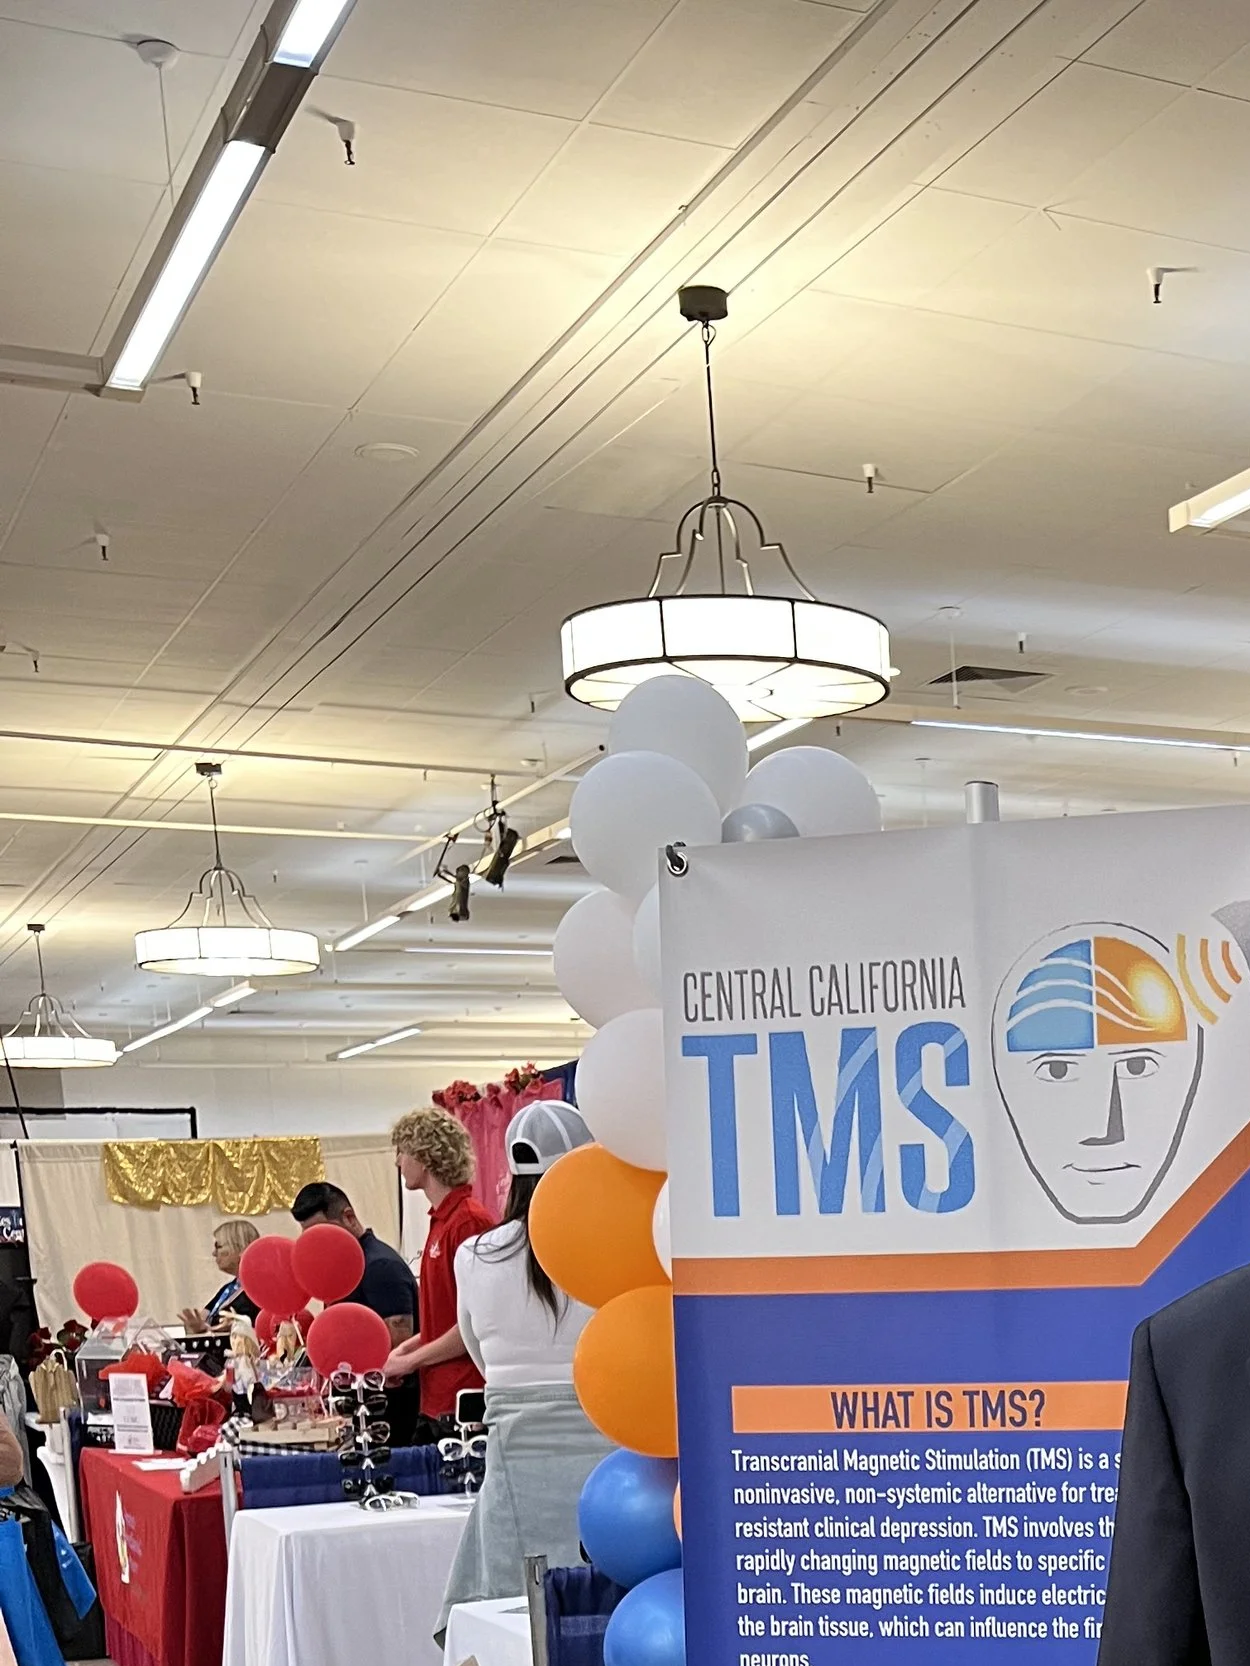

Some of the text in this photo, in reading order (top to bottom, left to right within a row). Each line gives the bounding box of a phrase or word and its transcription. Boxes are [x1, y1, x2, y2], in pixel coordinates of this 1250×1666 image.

[683, 956, 966, 1023] CENTRAL CALIFORNIA
[682, 1021, 975, 1218] TMS
[831, 1390, 1046, 1429] WHAT IS TMS?
[731, 1448, 840, 1472] Transcranial
[843, 1448, 921, 1477] Magnetic
[924, 1447, 1021, 1471] Stimulation
[1026, 1447, 1073, 1473] (TMS)
[1078, 1447, 1094, 1470] is
[1098, 1452, 1109, 1470] a
[845, 1481, 963, 1510] non-systemic
[966, 1480, 1057, 1504] alternative
[1060, 1480, 1087, 1503] for
[735, 1515, 1115, 1544] resistant clinical depression. TMS involves th
[736, 1548, 1106, 1577] rapidly changing magnetic fields to specific
[737, 1582, 1107, 1610] brain. These magnetic fields induce electric
[737, 1614, 766, 1637] the
[770, 1614, 814, 1637] brain
[878, 1615, 930, 1637] which
[934, 1621, 965, 1638] can
[969, 1615, 1048, 1639] influence
[1051, 1616, 1079, 1639] the
[1083, 1616, 1103, 1639] fir
